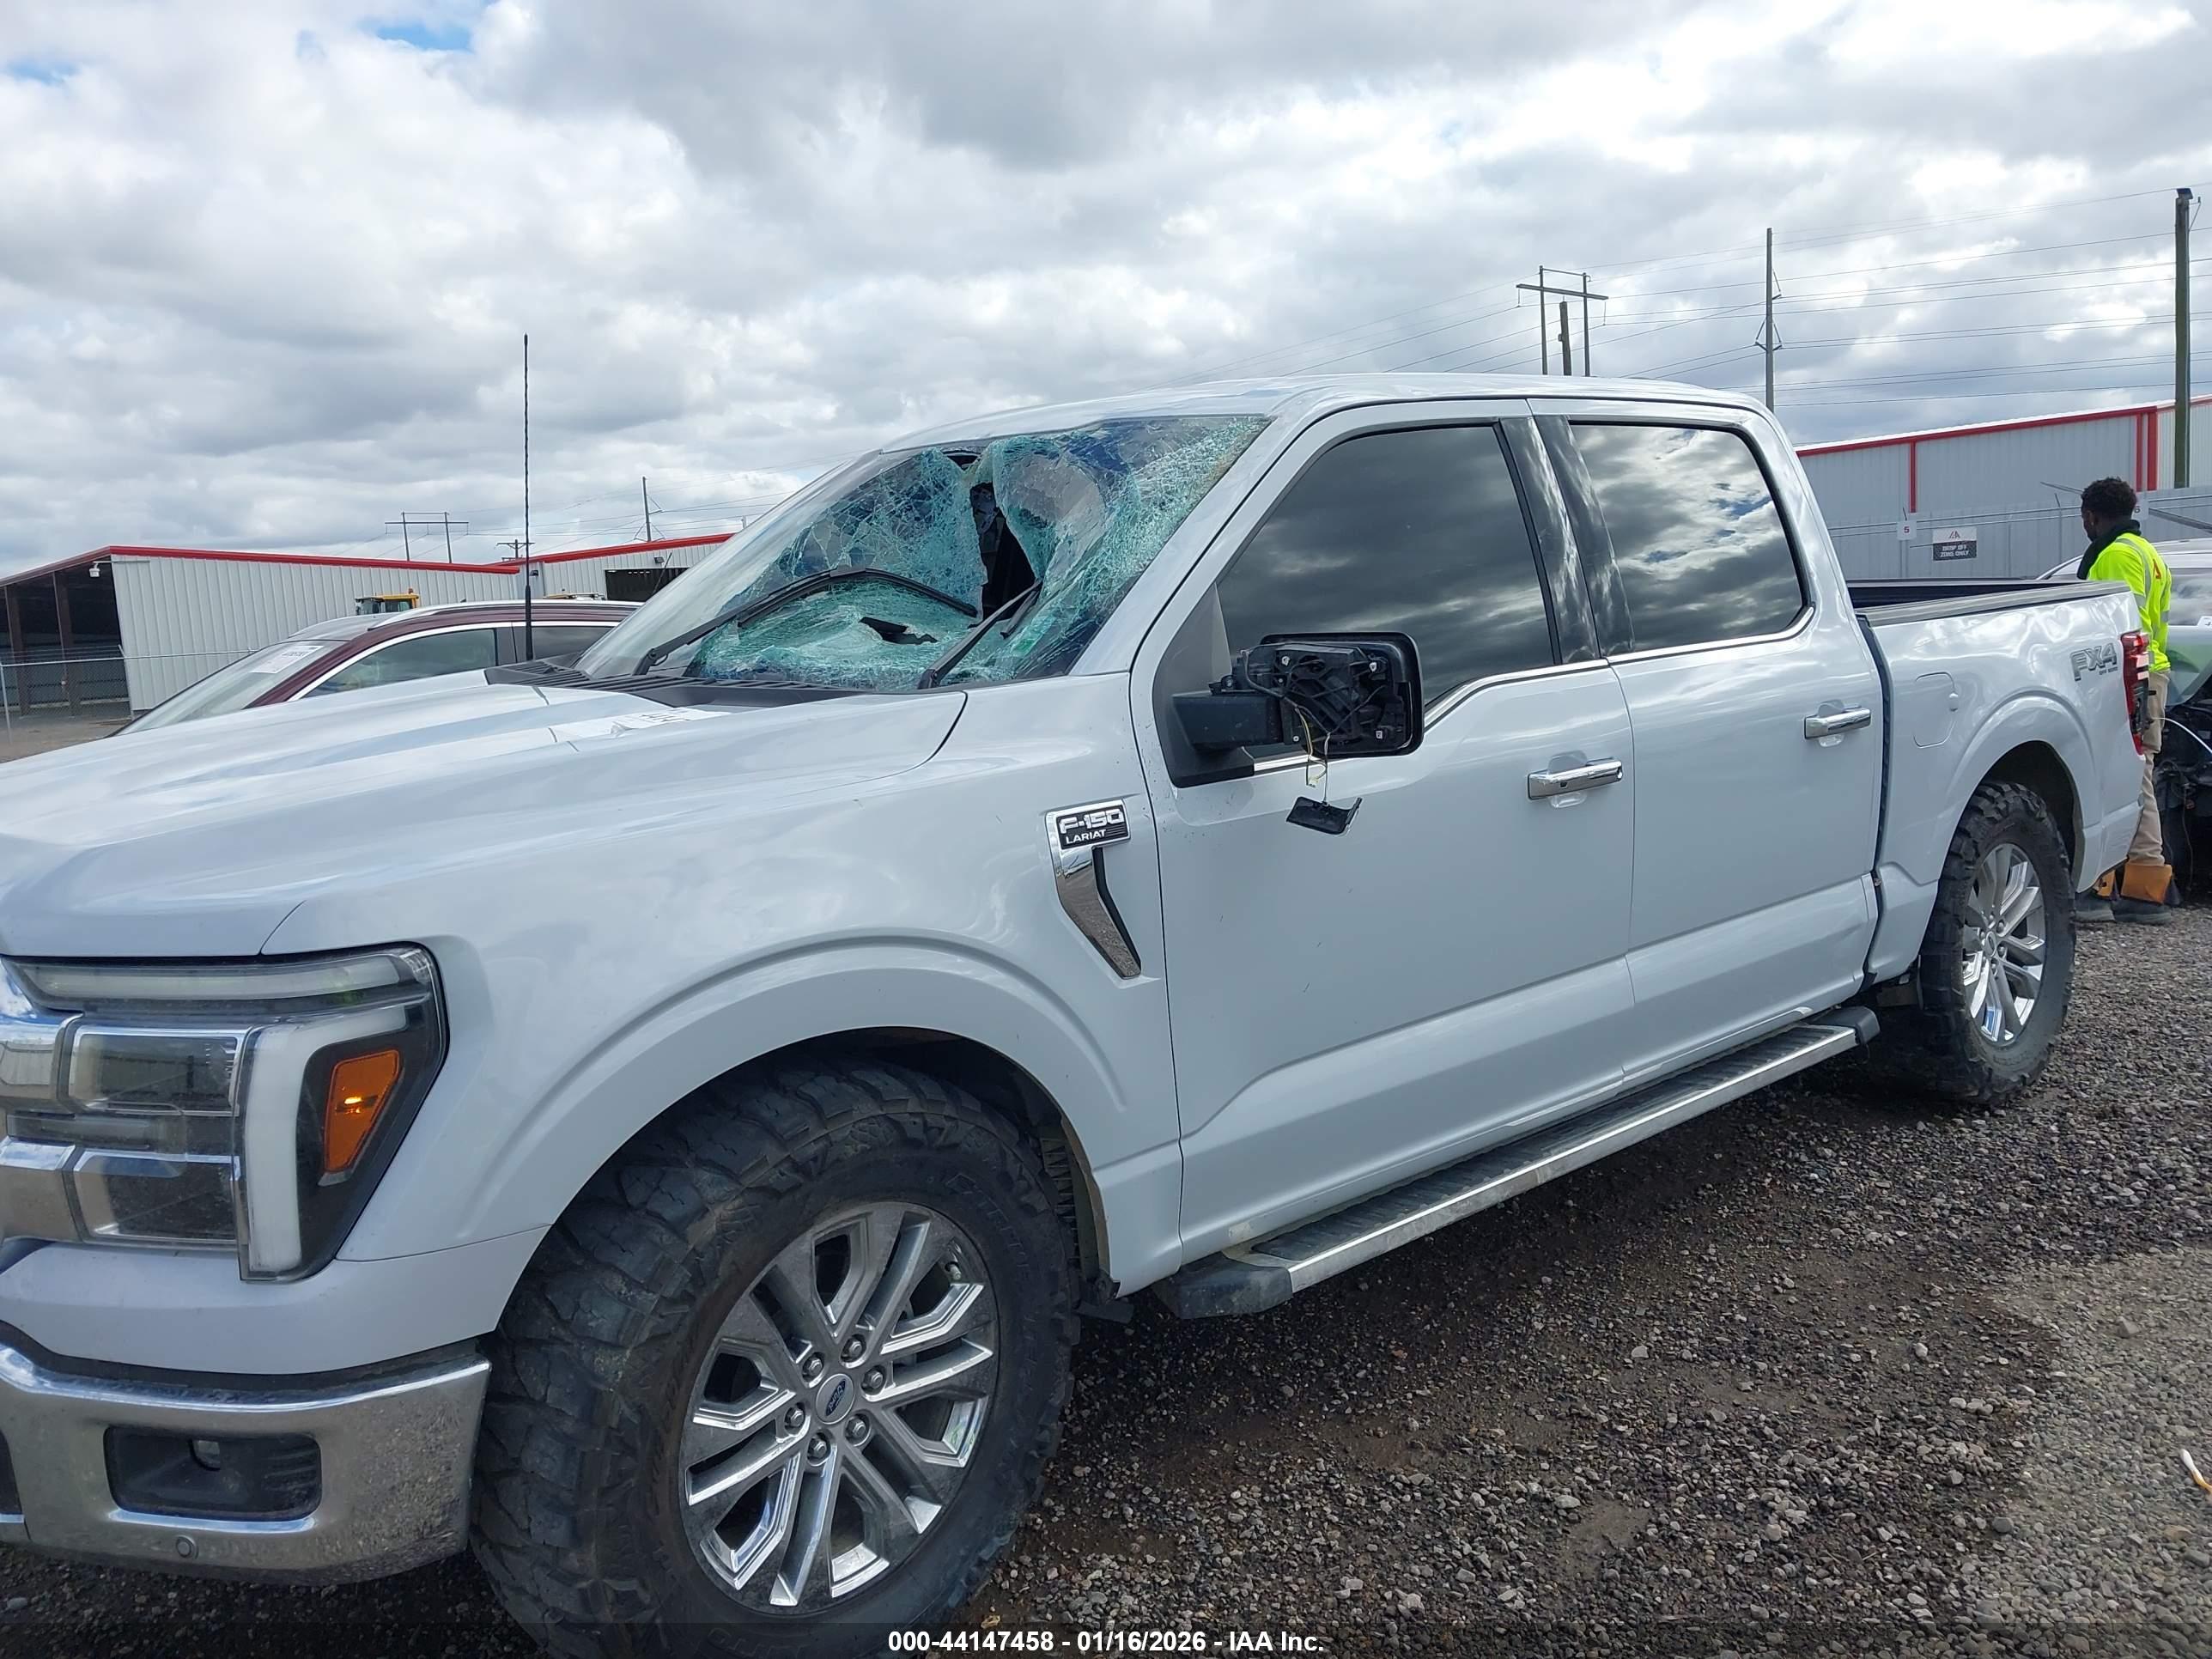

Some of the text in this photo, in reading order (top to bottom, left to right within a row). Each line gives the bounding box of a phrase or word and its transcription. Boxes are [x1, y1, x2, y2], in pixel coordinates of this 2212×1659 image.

[2070, 643, 2118, 681] FX4
[1059, 808, 1125, 835] F-150
[1066, 829, 1107, 844] LARIAT
